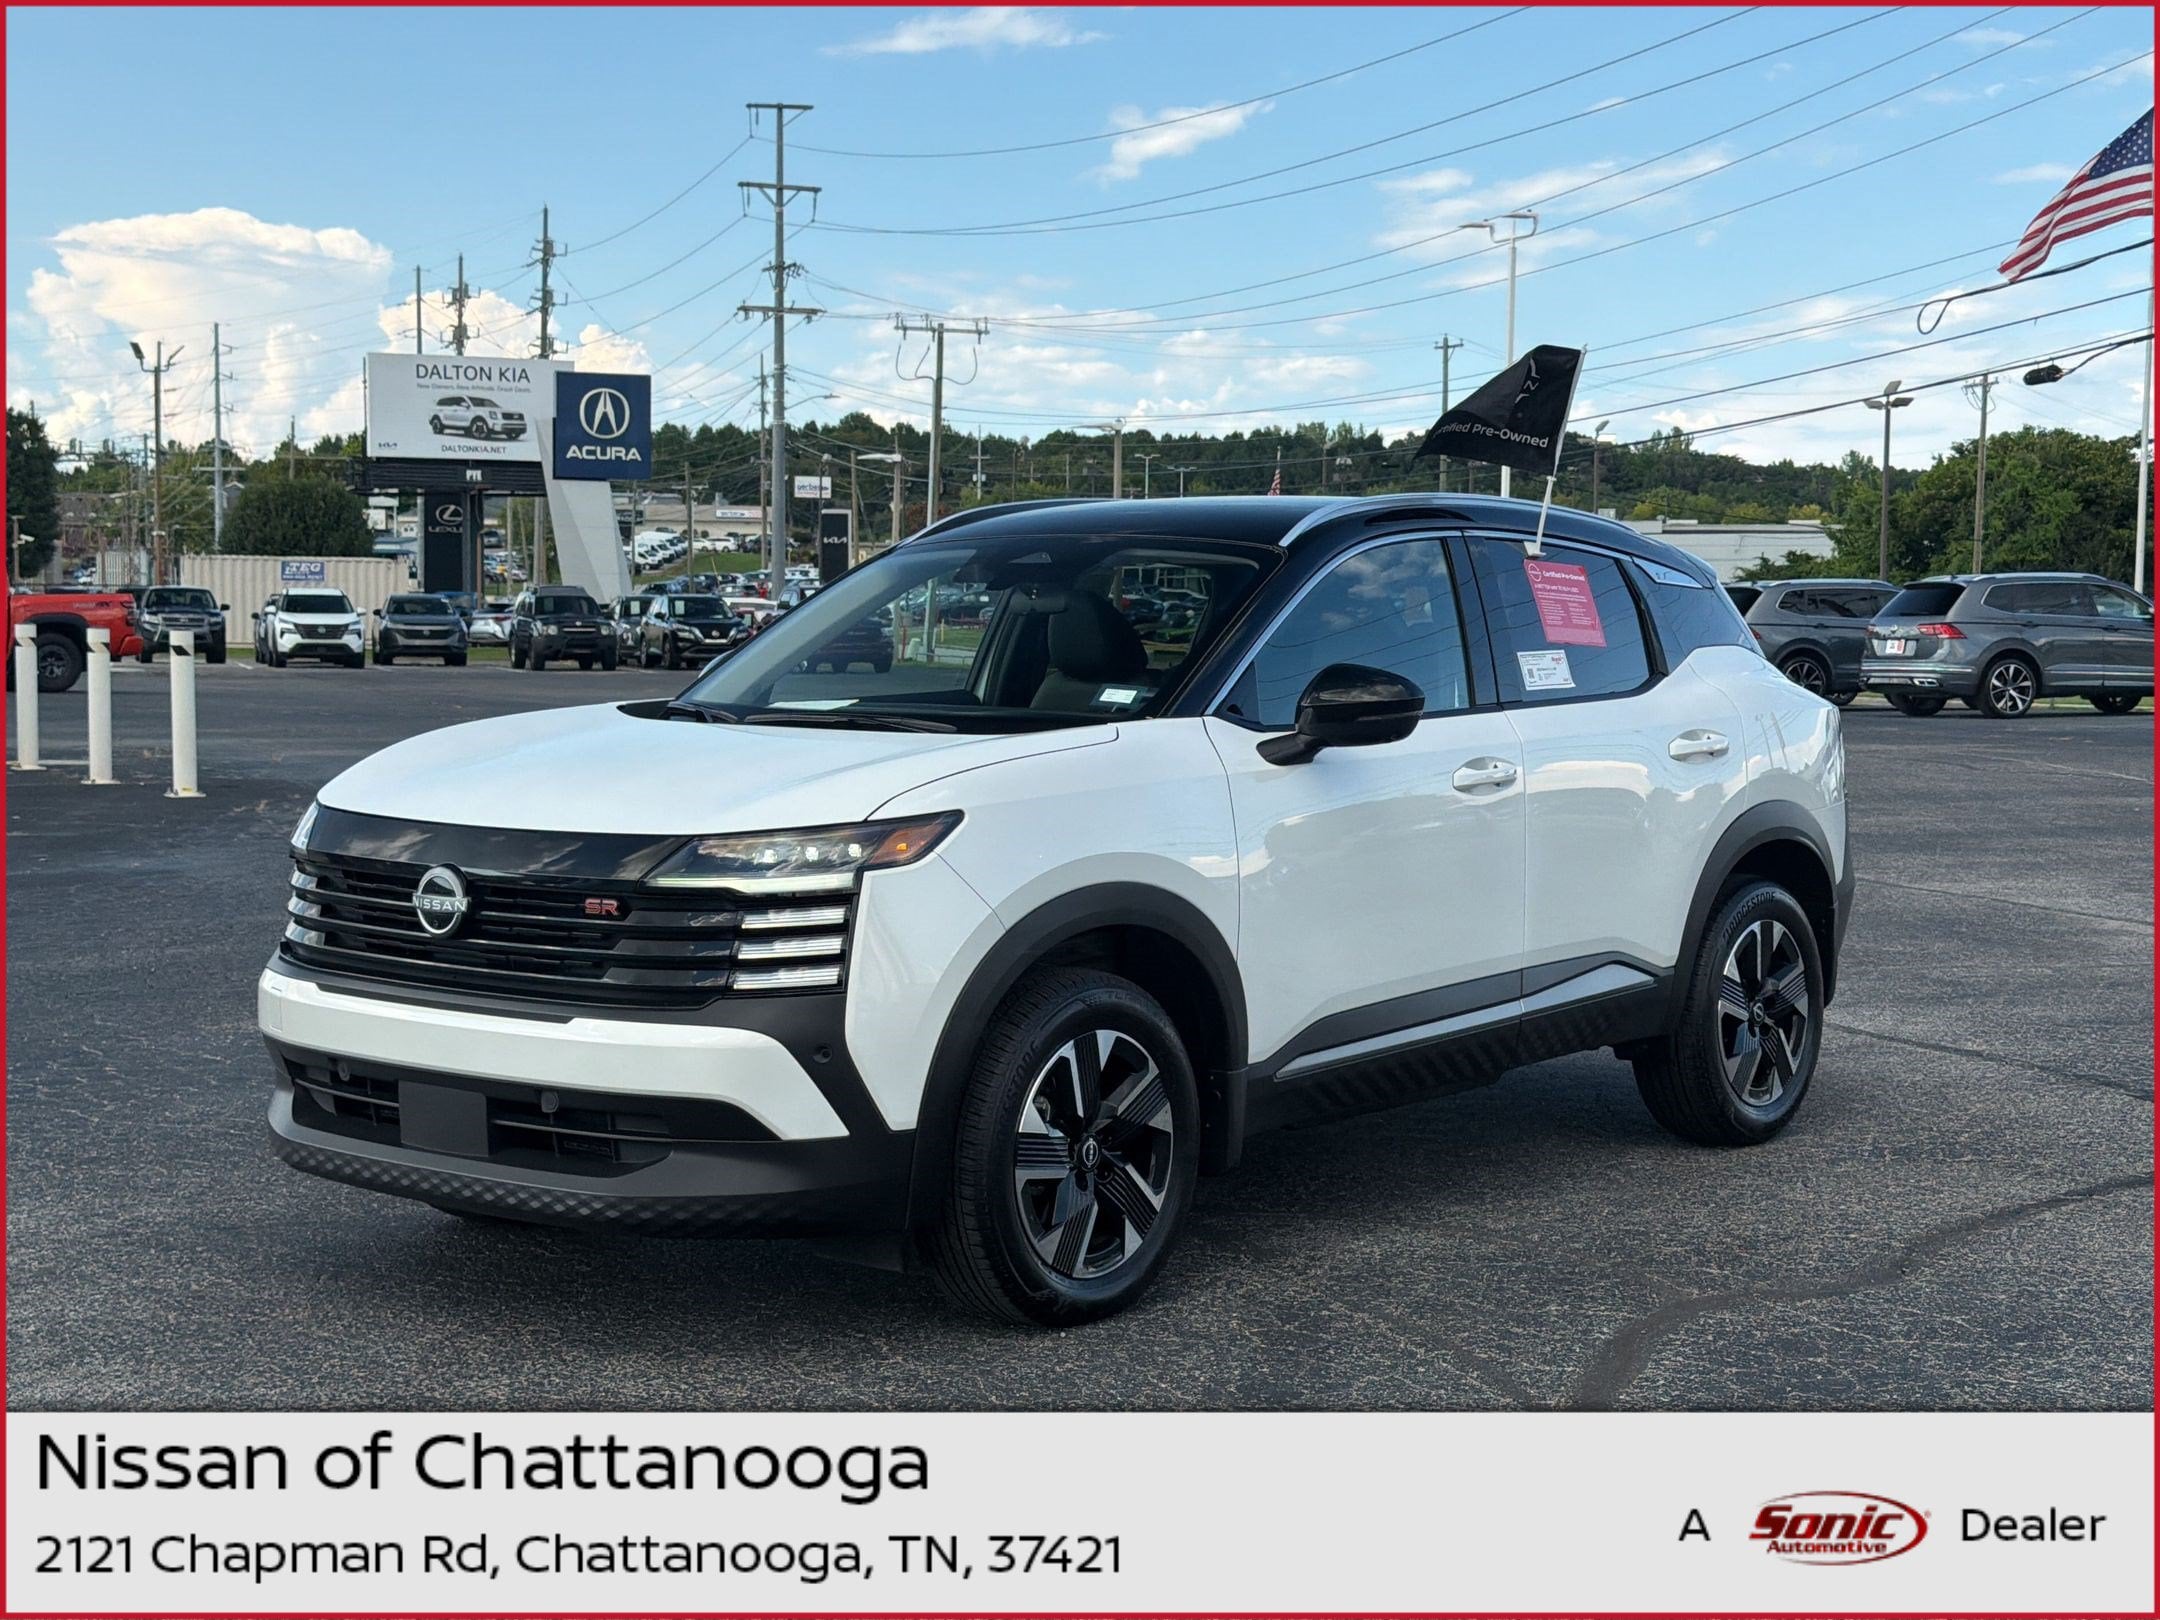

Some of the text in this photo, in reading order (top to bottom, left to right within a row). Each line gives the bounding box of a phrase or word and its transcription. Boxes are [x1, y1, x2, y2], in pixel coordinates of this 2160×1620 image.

[416, 363, 531, 384] DALTON KIA
[1472, 423, 1549, 448] Pre-Owned
[441, 444, 507, 454] DALTONKIA.NET
[566, 445, 642, 461] ACURA
[412, 894, 466, 911] NISSAN
[584, 898, 619, 915] SR
[1721, 890, 1776, 942] BRIDGESTONE
